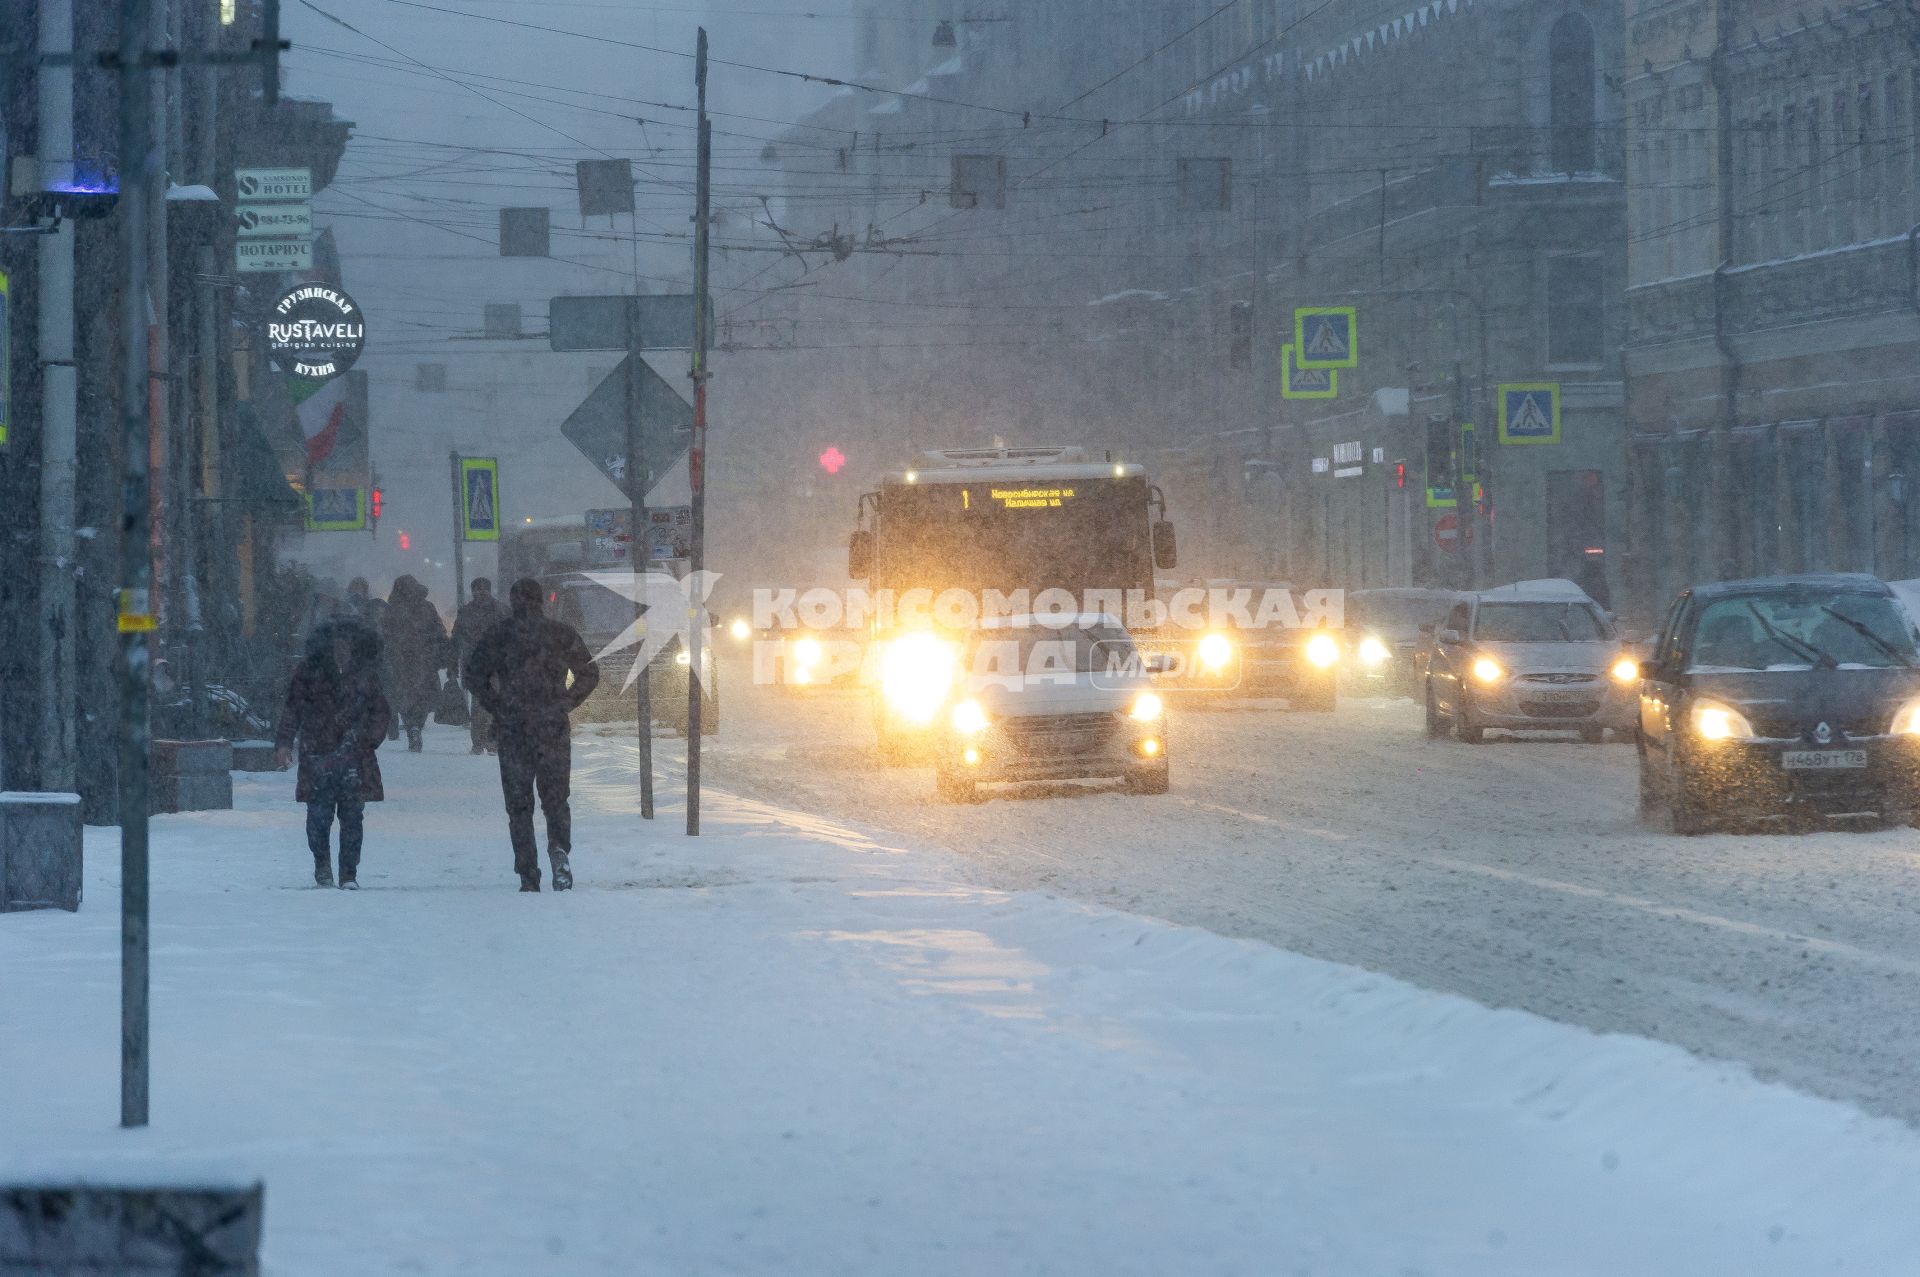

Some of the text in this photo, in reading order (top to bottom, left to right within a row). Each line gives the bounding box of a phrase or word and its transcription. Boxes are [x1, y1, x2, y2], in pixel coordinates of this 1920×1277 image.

[263, 185, 309, 194] HOTEL
[240, 244, 309, 256] НОТАРИУС
[277, 288, 352, 315] ГРУЗИНСКАЯ
[268, 319, 363, 342] RUSTAVELI
[271, 342, 316, 350] georgian
[294, 362, 336, 377] КУХНЯ
[962, 490, 969, 509] 1
